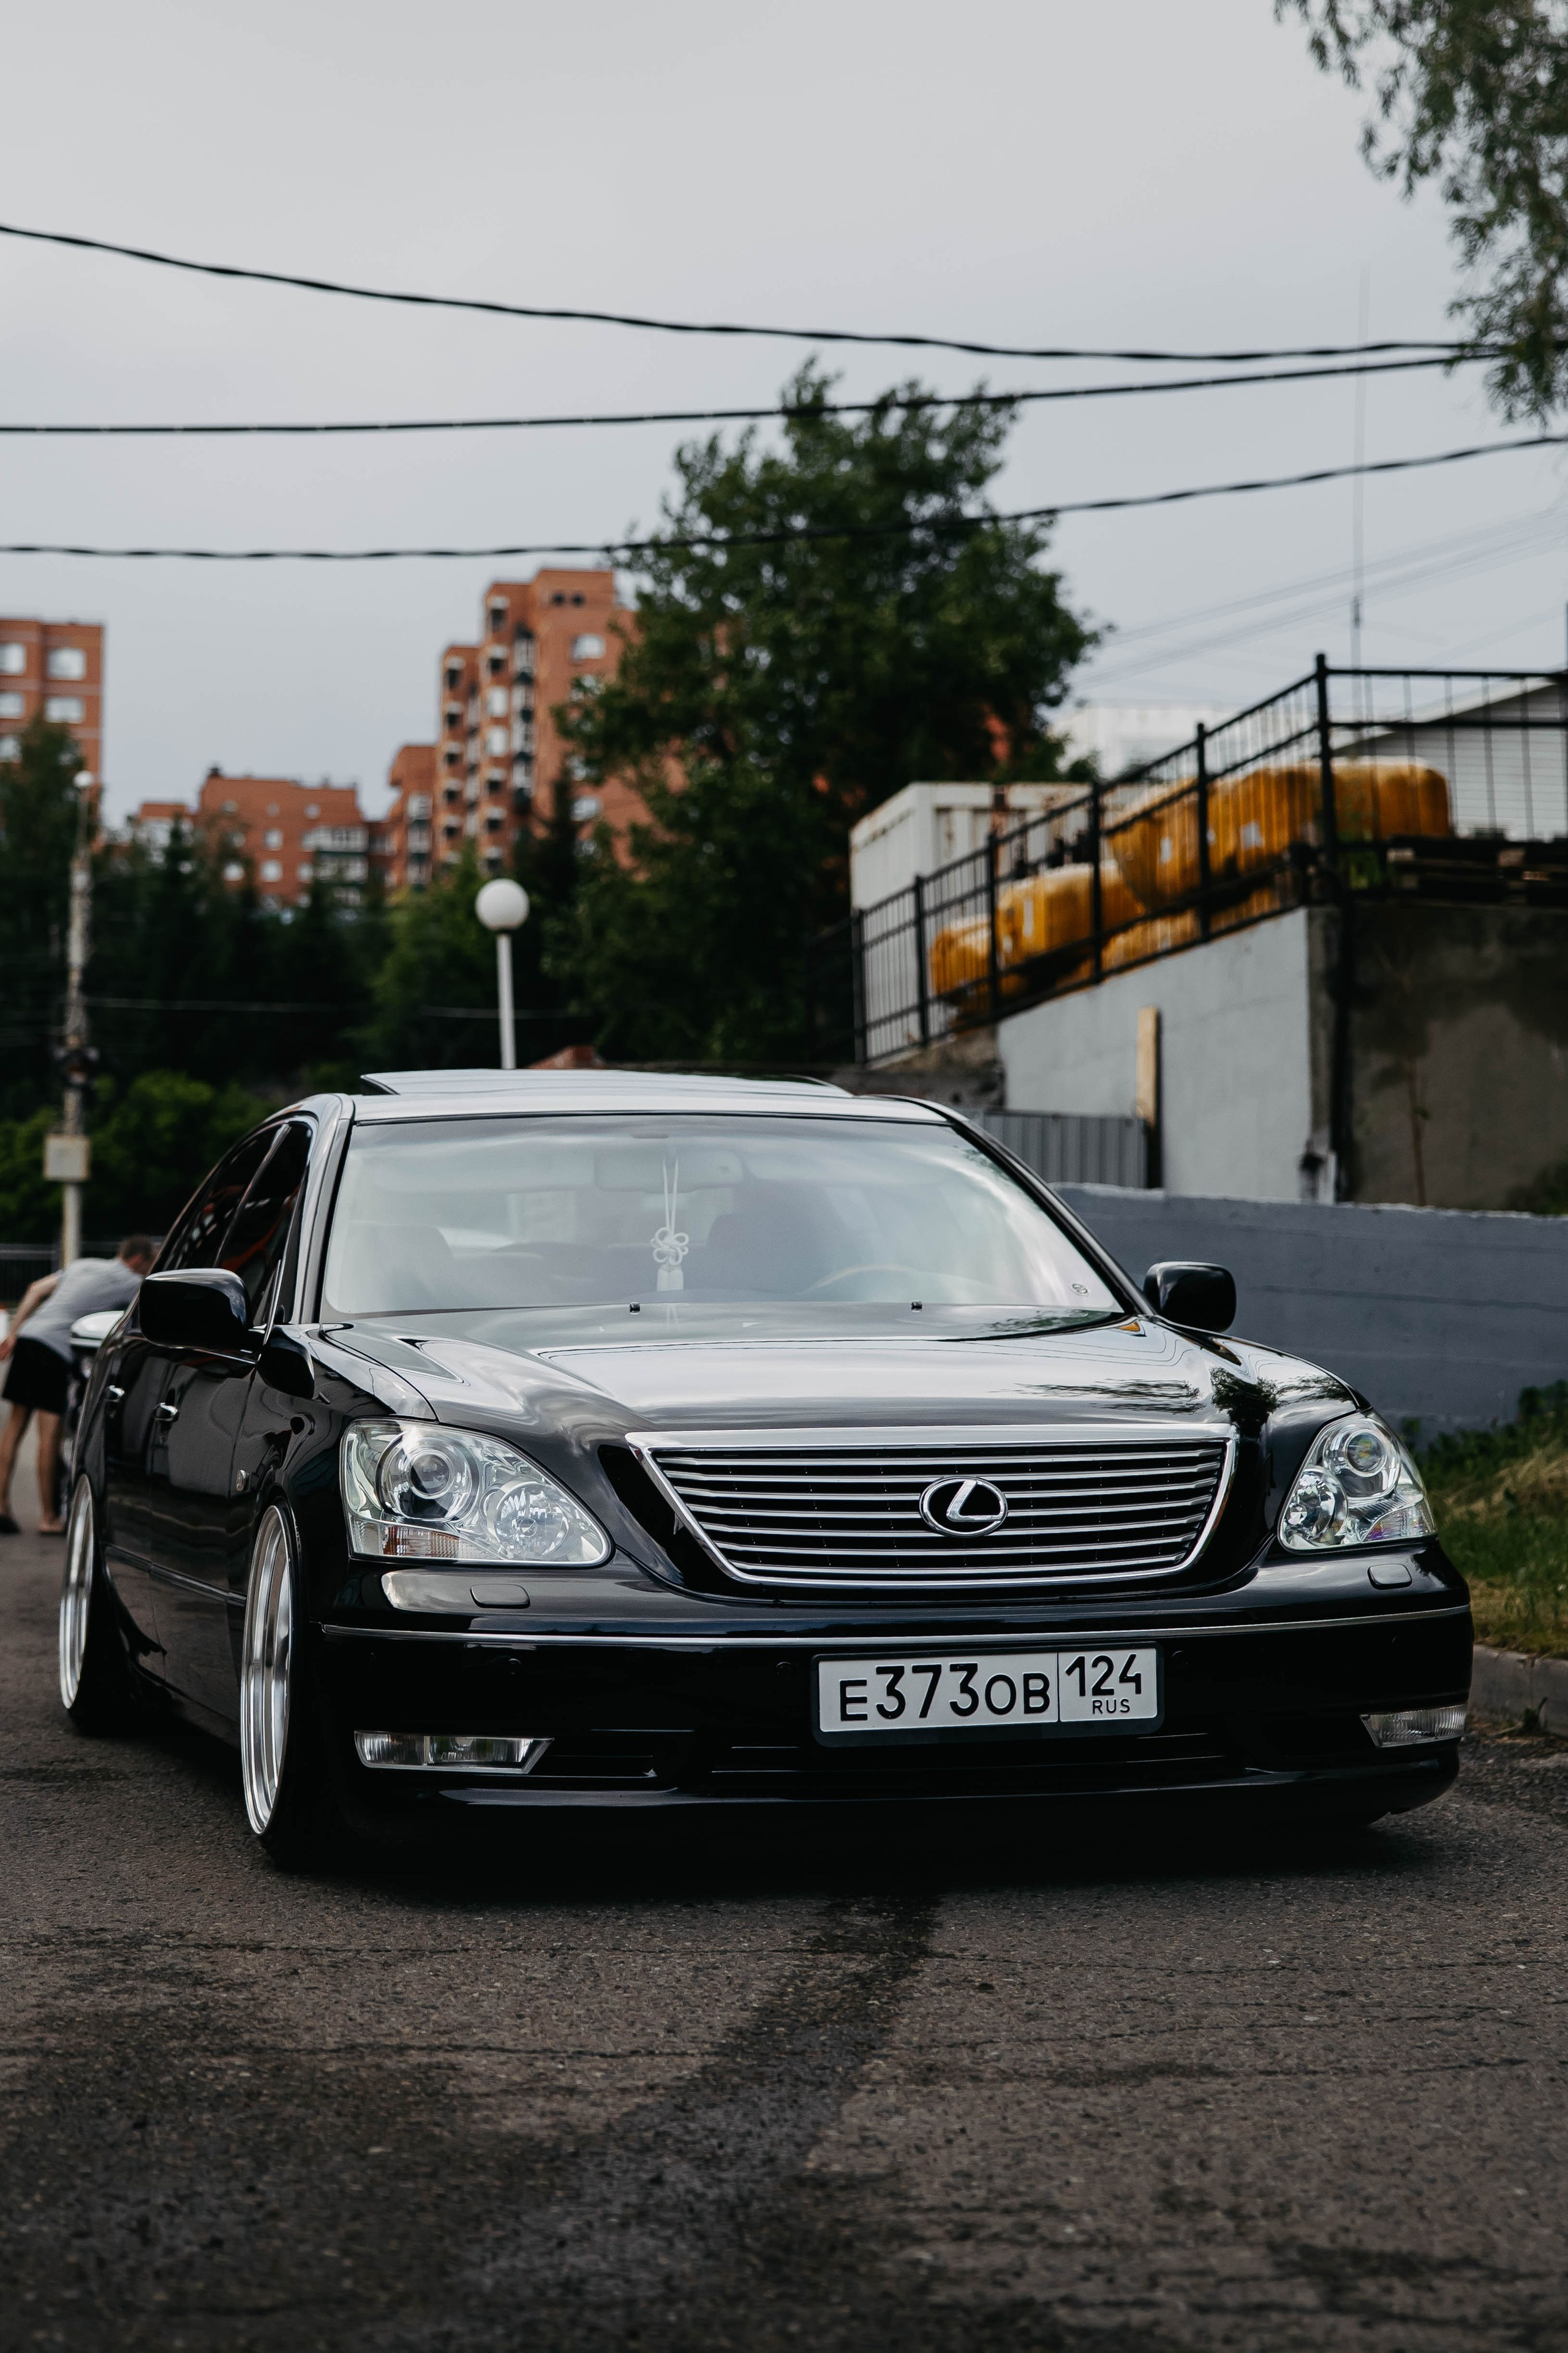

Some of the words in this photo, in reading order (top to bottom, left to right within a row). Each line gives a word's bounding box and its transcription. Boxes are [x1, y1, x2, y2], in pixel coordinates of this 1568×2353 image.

[839, 1663, 1050, 1722] E373OB
[1065, 1653, 1142, 1697] 124
[1092, 1698, 1131, 1715] RUS
